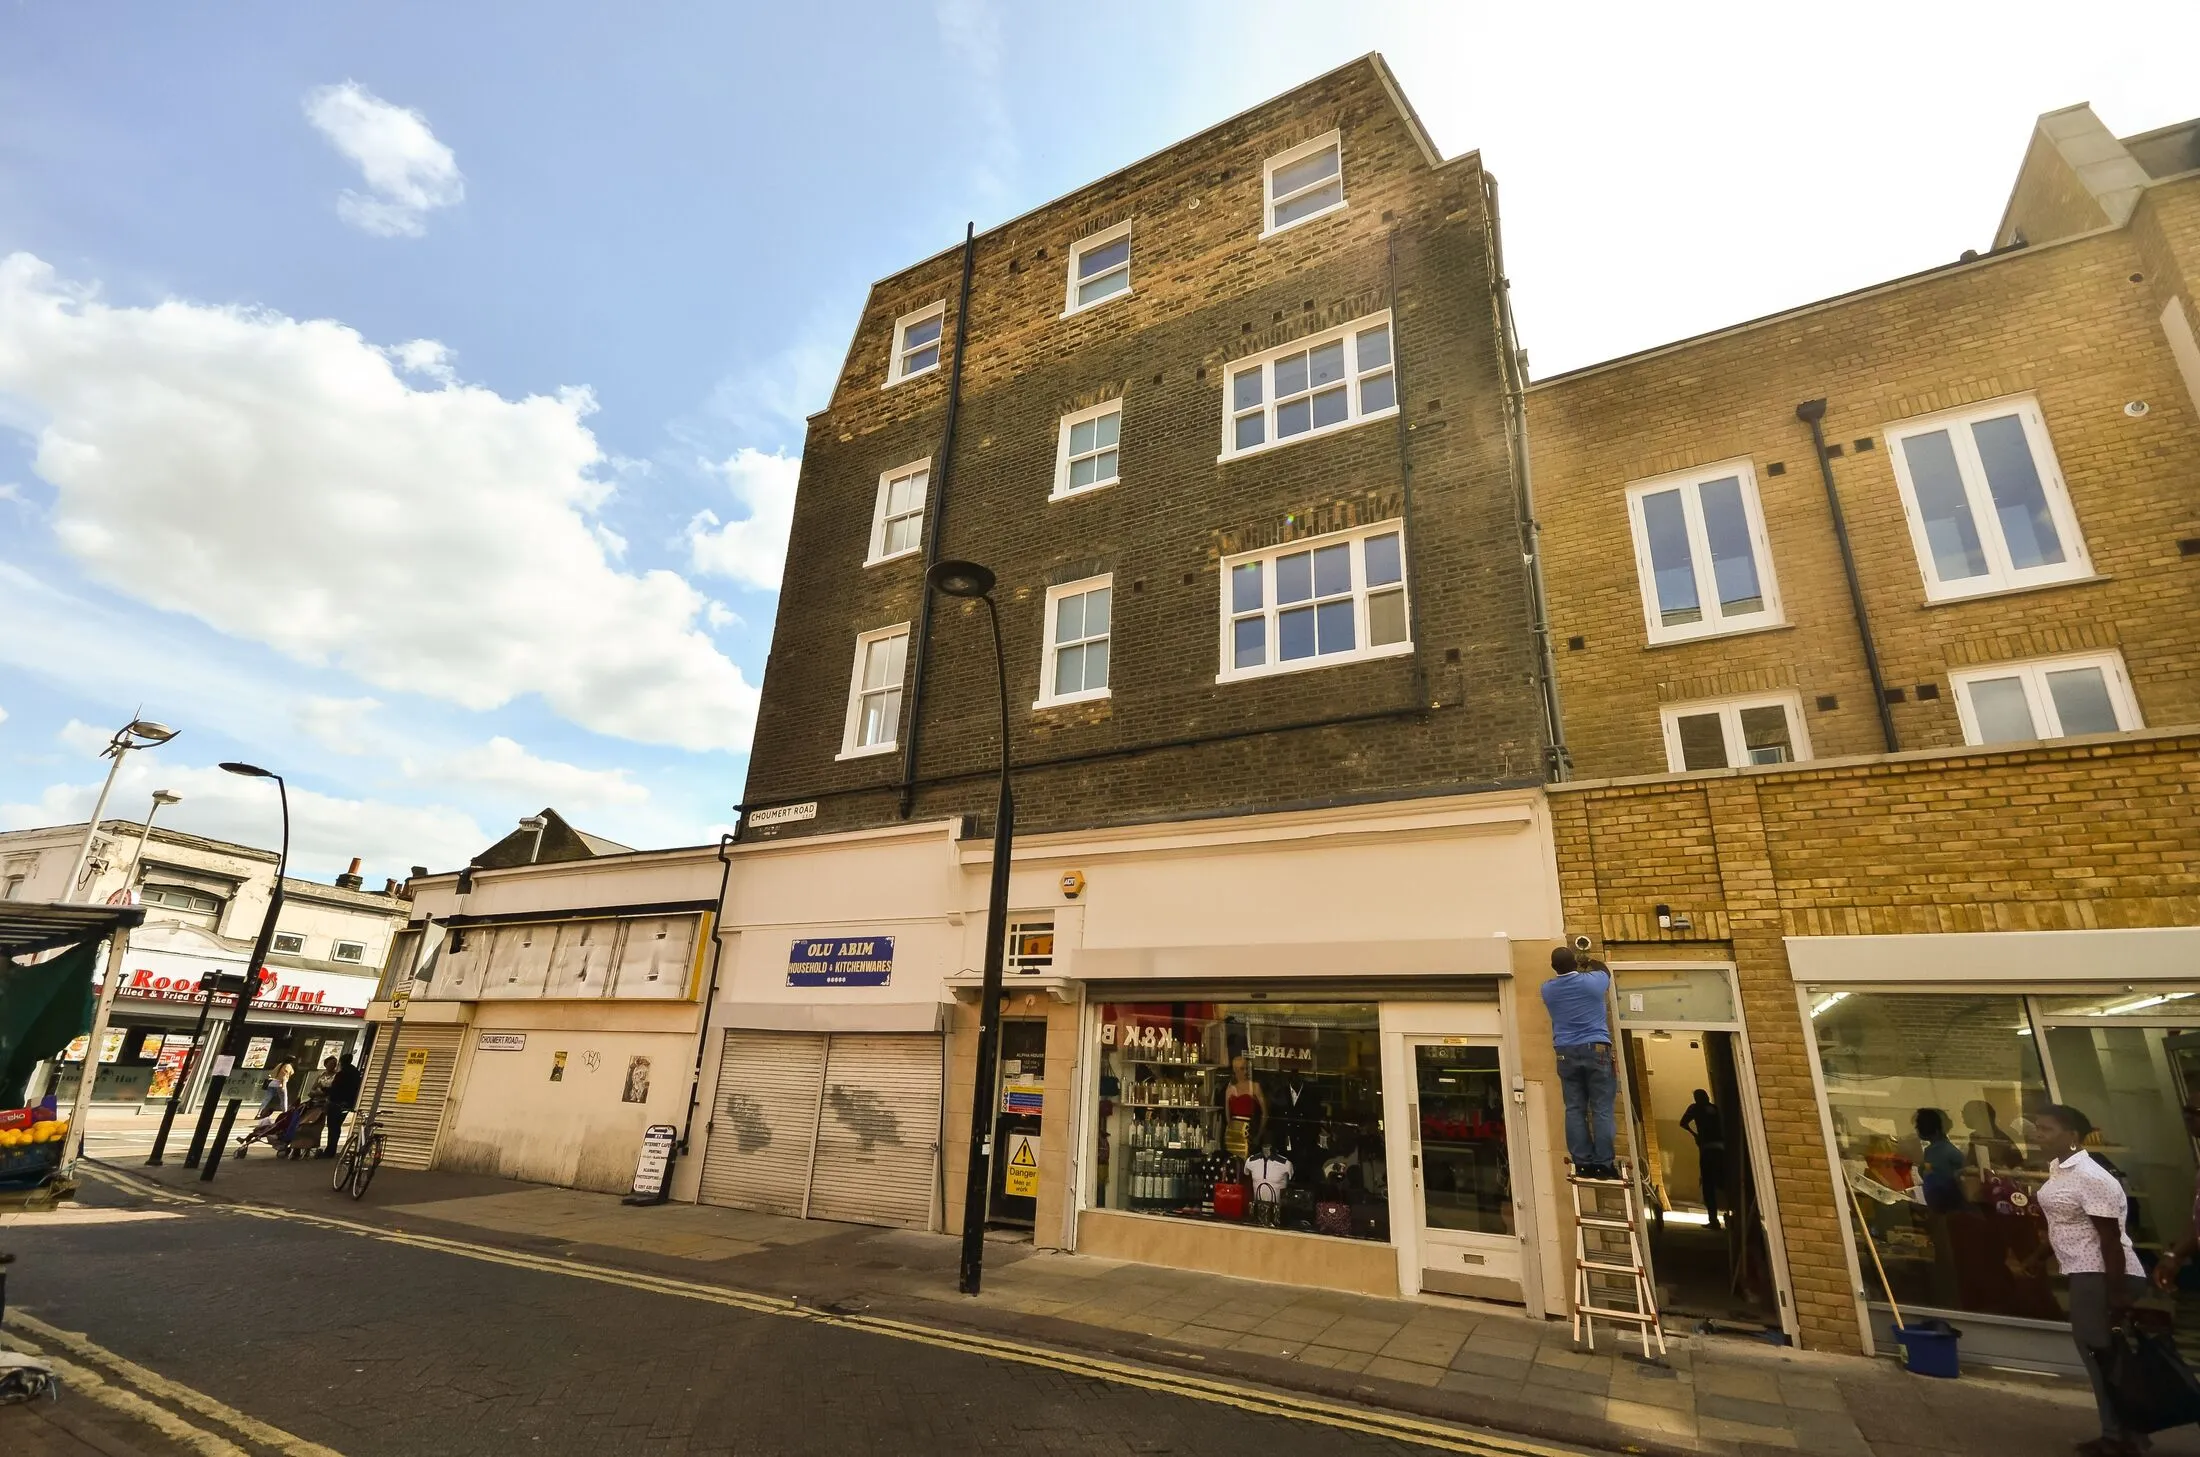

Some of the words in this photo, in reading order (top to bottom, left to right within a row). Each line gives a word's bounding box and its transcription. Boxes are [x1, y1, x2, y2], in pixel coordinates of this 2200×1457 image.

[751, 808, 792, 822] CHOUMERT
[794, 804, 815, 815] ROAD
[807, 943, 834, 957] OLU
[838, 942, 875, 956] ABIM
[788, 961, 828, 974] HOUSEHOLD
[829, 963, 833, 972] &
[834, 960, 892, 973] KITCHENWARES
[278, 984, 326, 1004] Hut
[149, 990, 158, 998] &
[163, 991, 189, 1000] Fried
[286, 1002, 304, 1011] Ribs
[311, 1004, 337, 1014] Pizzas
[481, 1035, 504, 1044] CHOUMERT
[505, 1036, 519, 1045] ROAD
[1010, 1168, 1037, 1178] Danger
